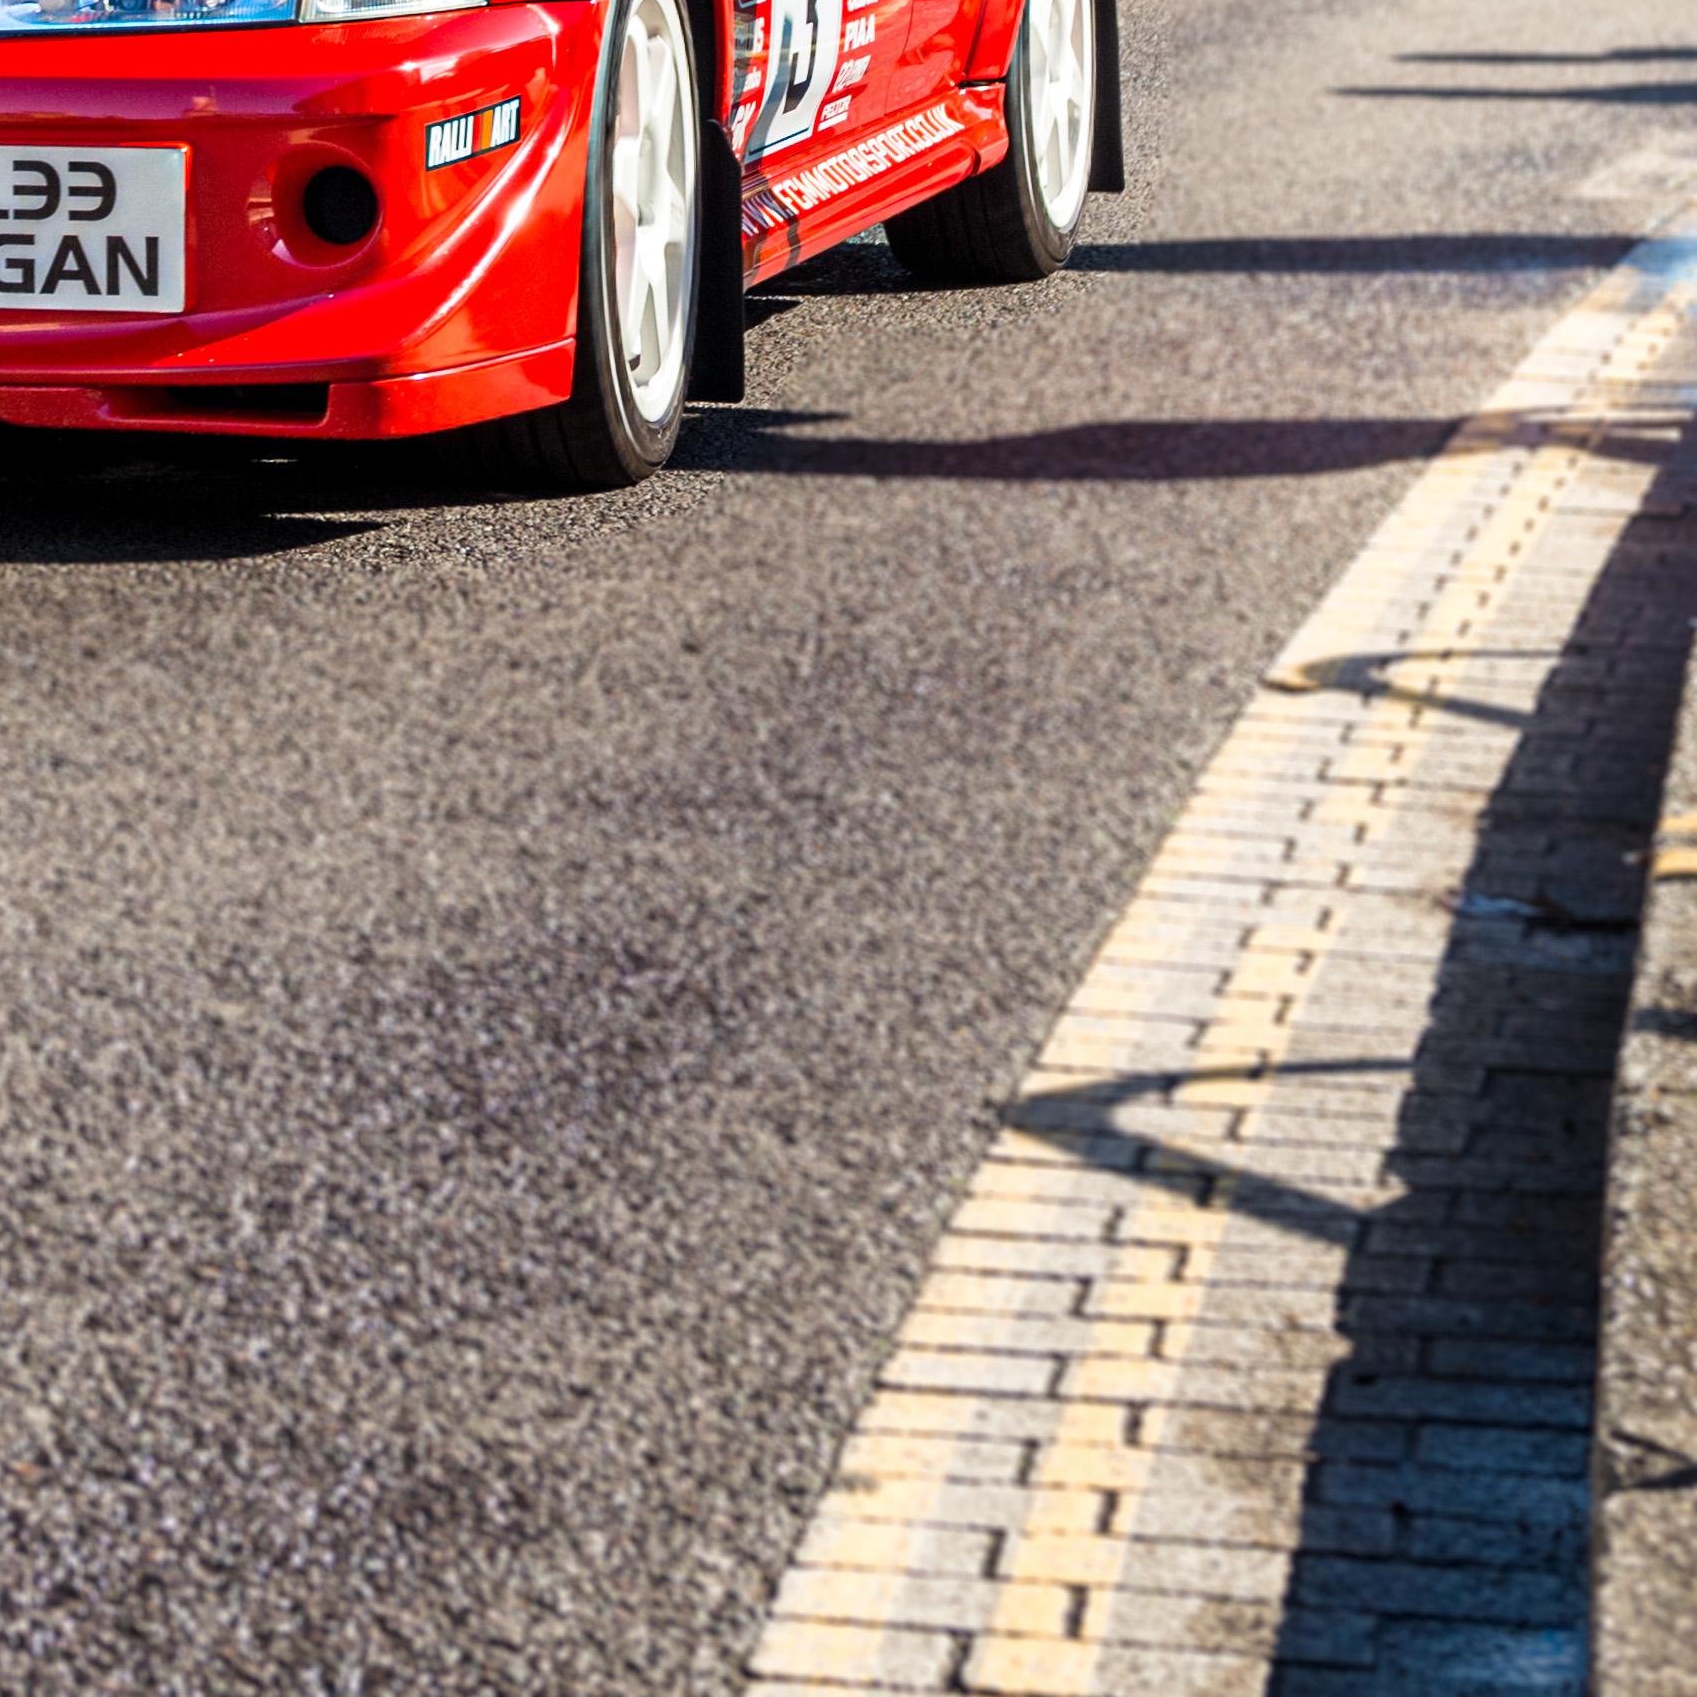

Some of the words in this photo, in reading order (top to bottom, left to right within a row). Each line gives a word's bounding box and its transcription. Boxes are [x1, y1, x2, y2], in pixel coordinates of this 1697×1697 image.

[843, 13, 876, 53] PIAA
[428, 115, 475, 168] RALLI
[490, 99, 520, 148] ART
